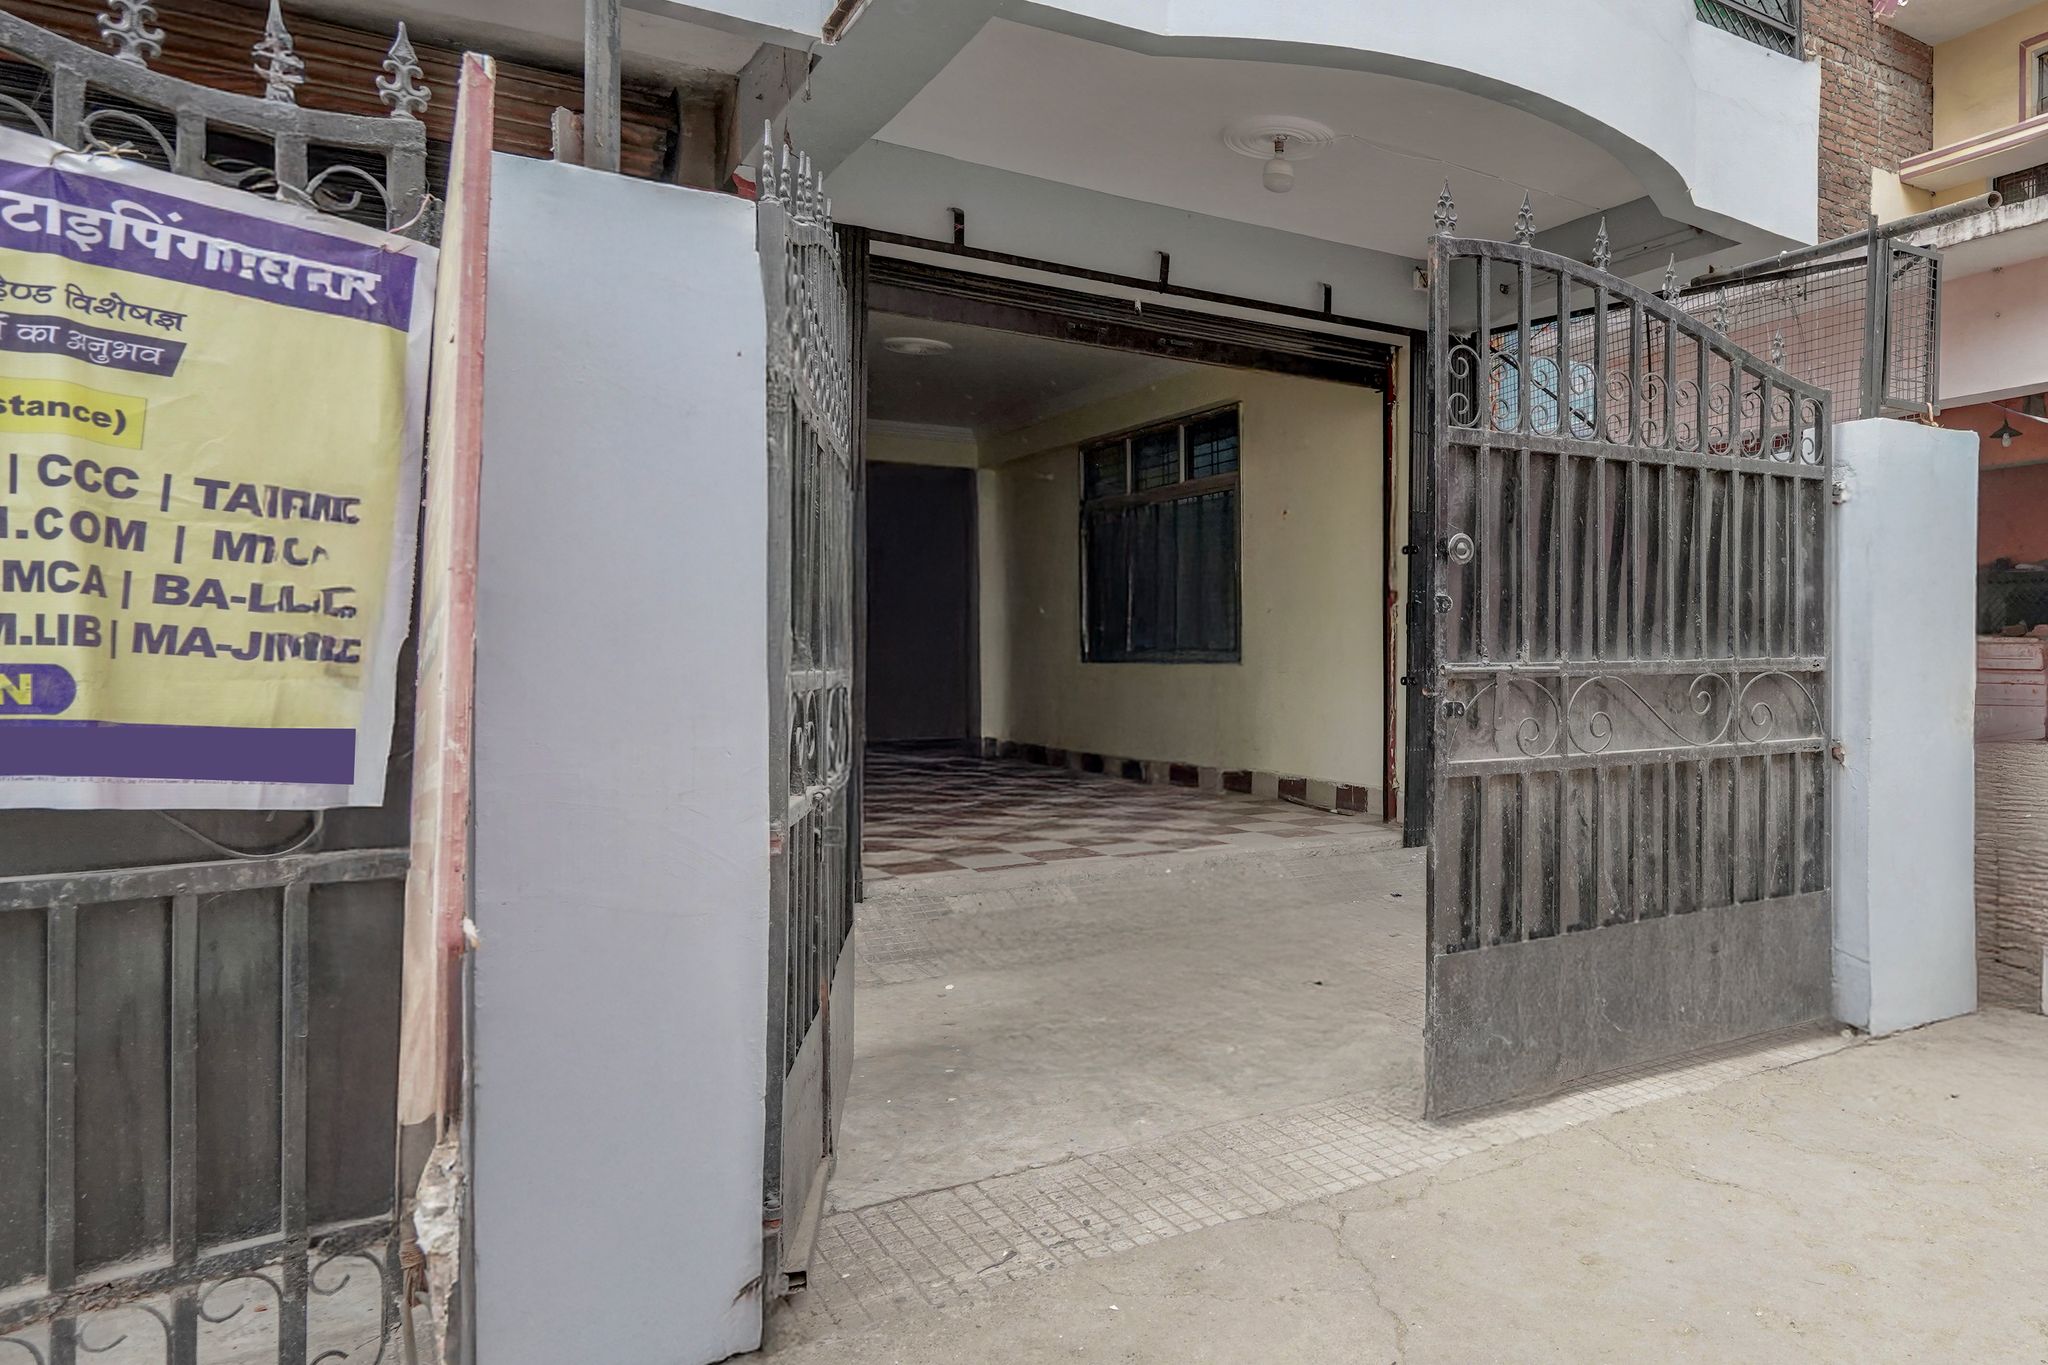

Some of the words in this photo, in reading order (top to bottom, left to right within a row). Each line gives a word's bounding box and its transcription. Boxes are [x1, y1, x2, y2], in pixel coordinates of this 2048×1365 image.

[64, 283, 188, 331] विशेषज्ञ
[16, 323, 61, 344] का
[66, 330, 165, 365] अनुभव
[37, 454, 140, 499] CCC
[0, 506, 147, 552] .COM
[2, 560, 108, 598] MCA
